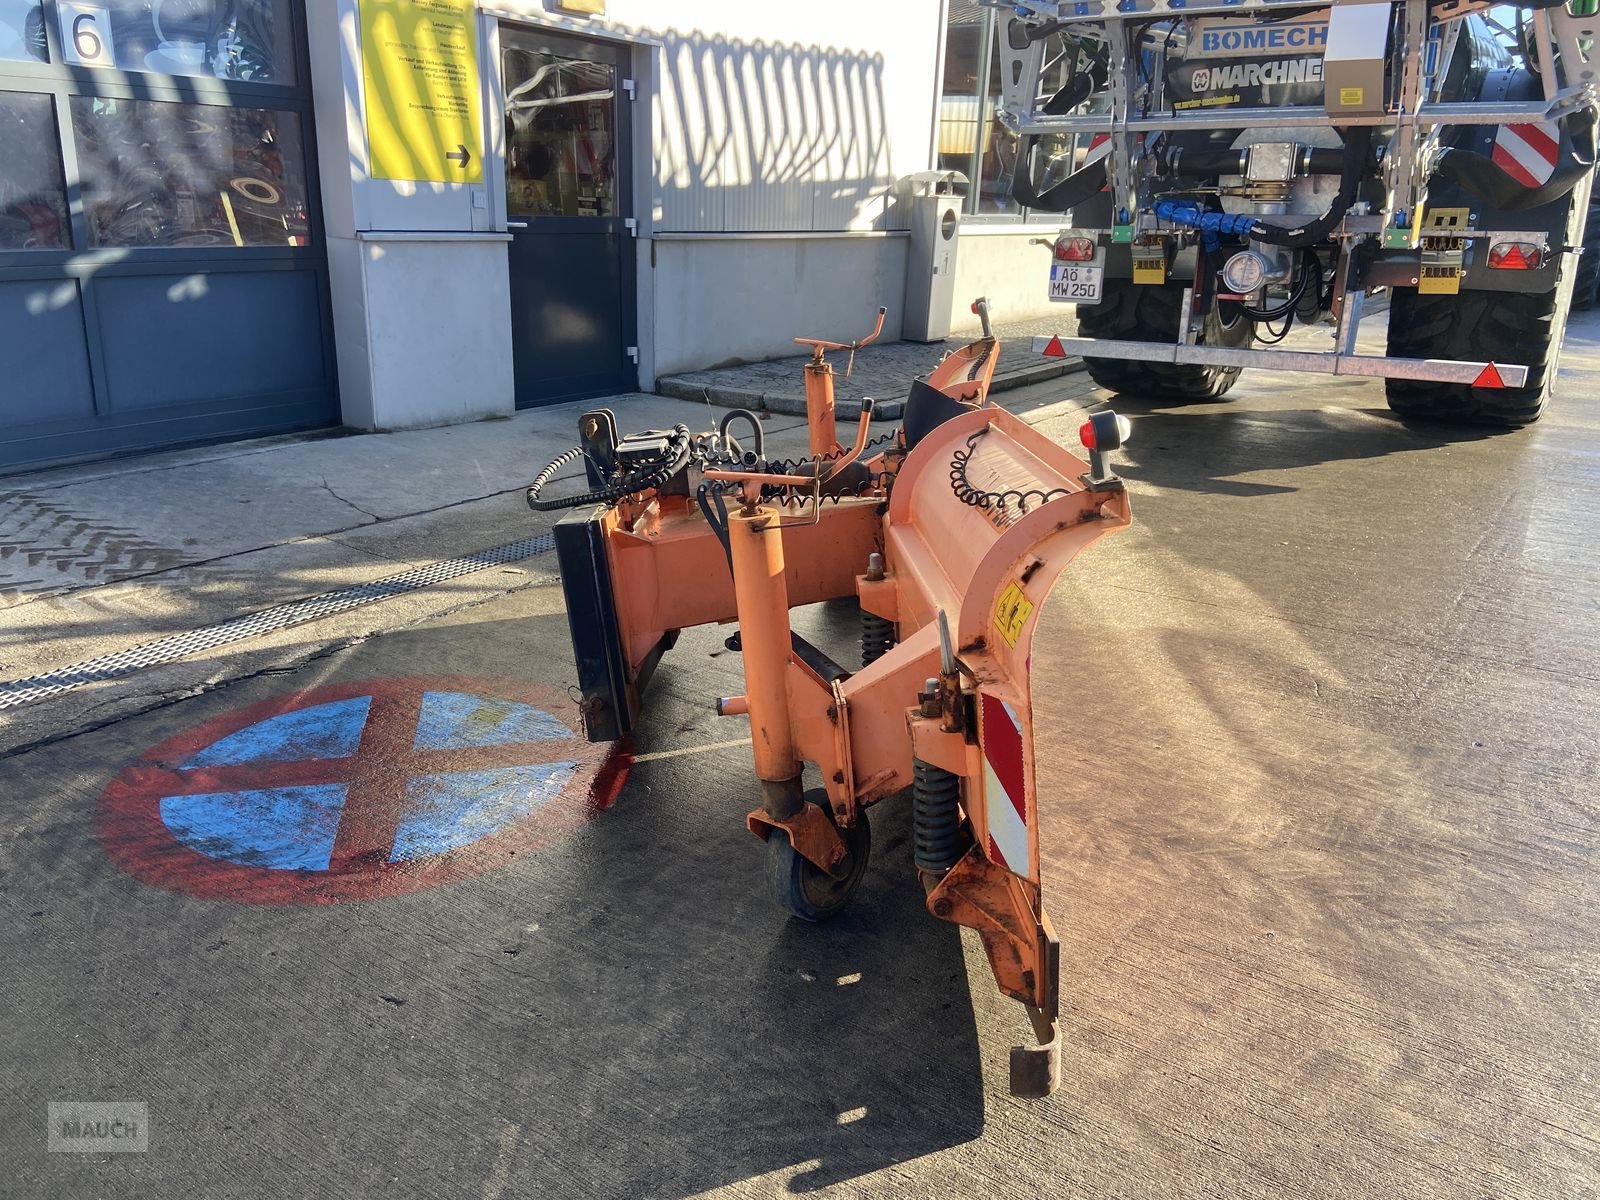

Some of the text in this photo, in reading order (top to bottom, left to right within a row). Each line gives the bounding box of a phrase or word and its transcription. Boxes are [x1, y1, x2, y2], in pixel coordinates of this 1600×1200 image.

[72, 13, 102, 60] 6
[1202, 26, 1329, 51] BOMECH
[1211, 58, 1325, 91] MARCHNE
[1061, 268, 1079, 281] AÖ
[1051, 282, 1096, 297] MW 250
